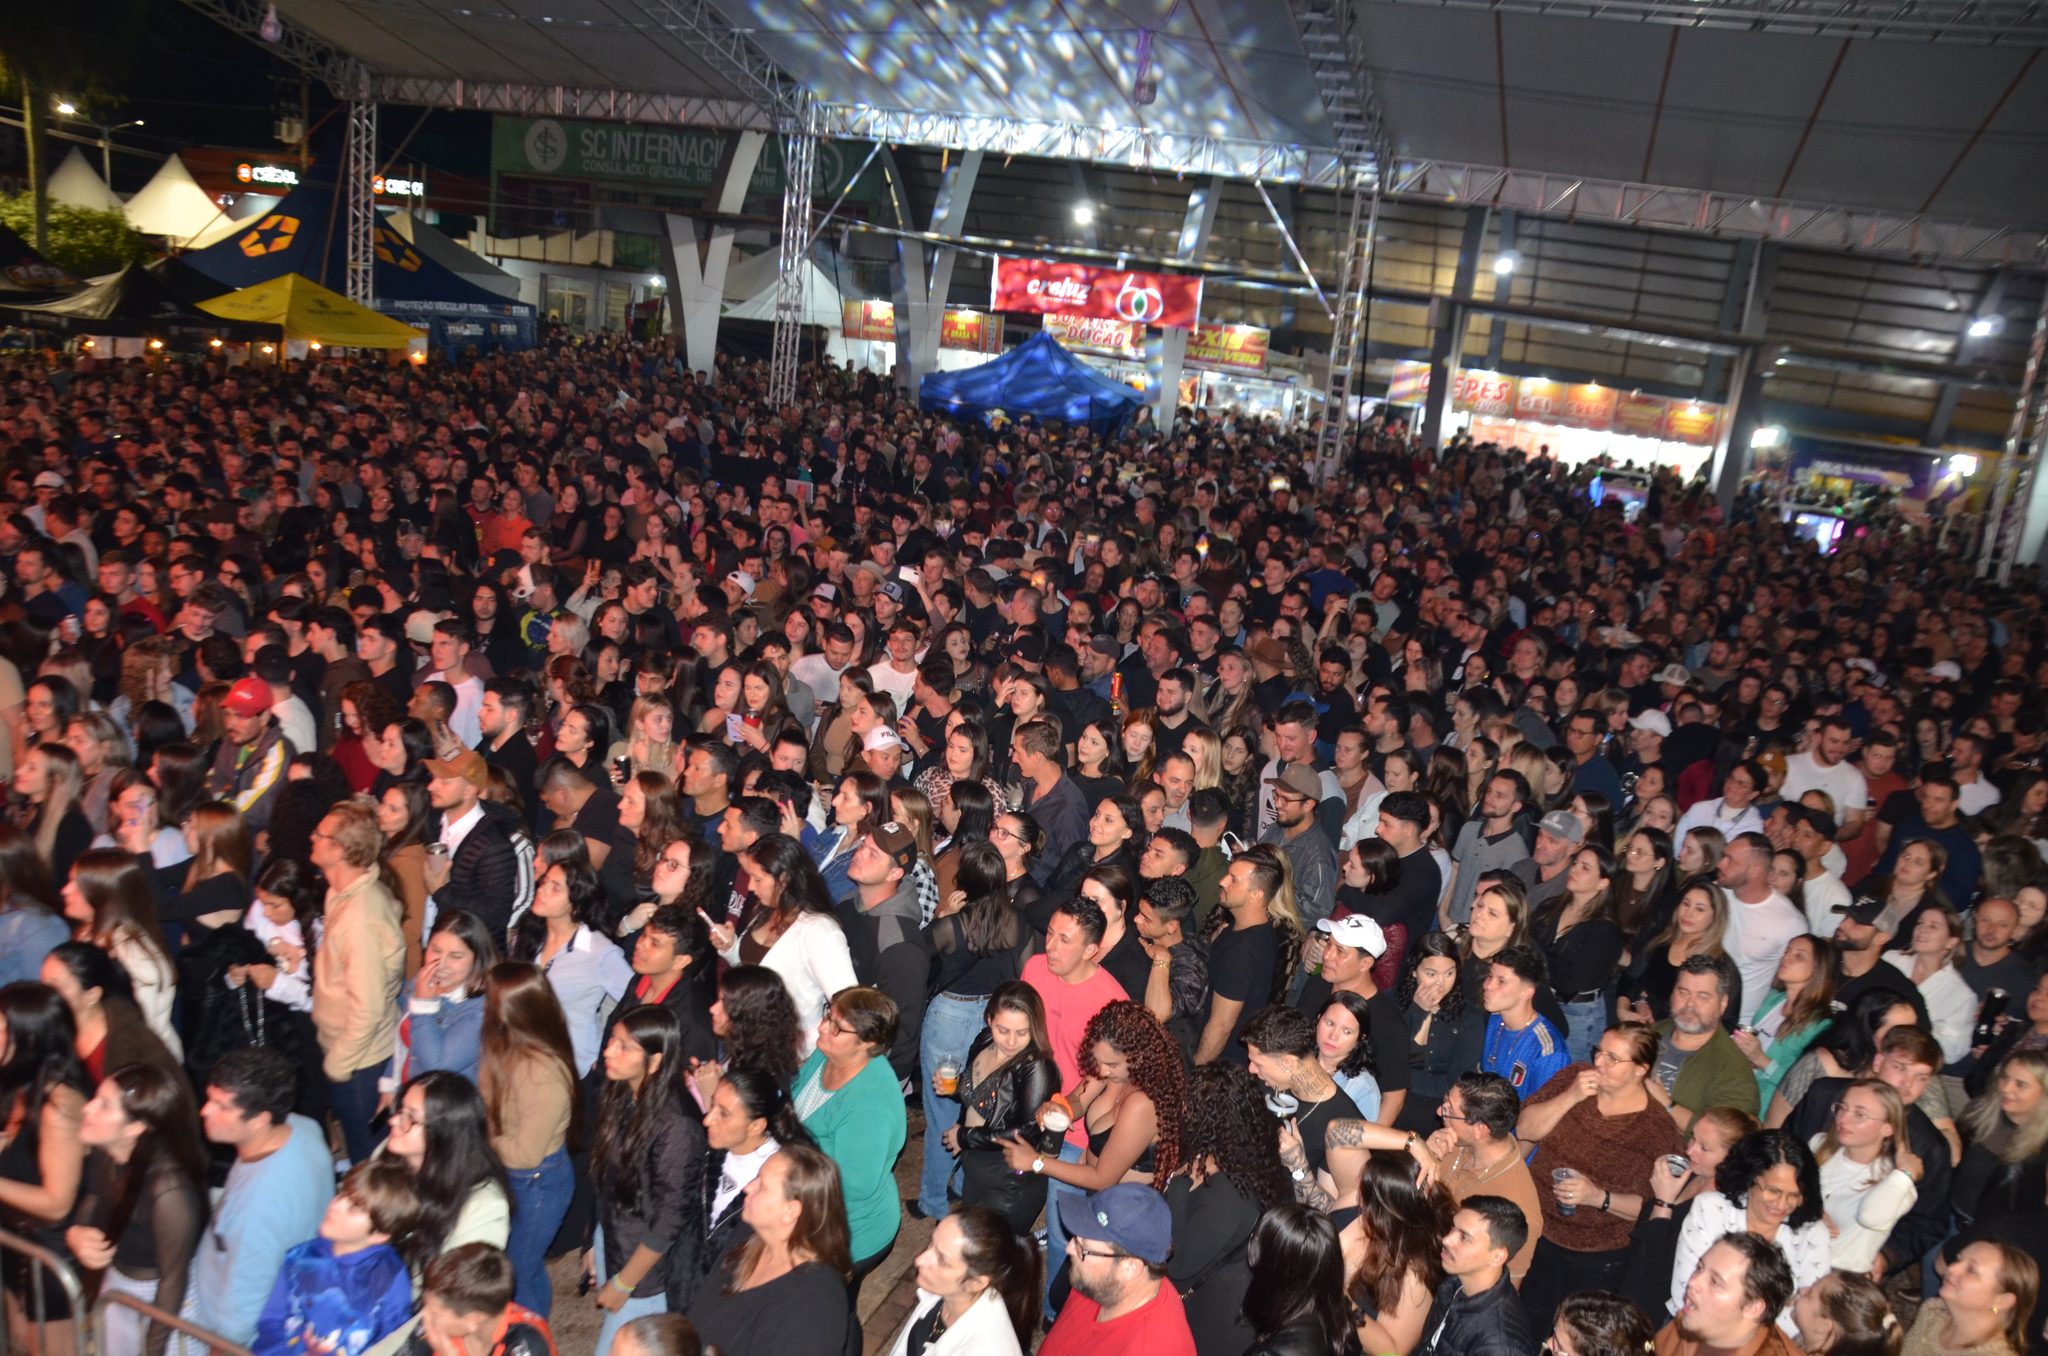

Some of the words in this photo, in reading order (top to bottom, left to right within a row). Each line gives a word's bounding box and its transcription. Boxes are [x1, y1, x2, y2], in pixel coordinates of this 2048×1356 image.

[580, 128, 607, 159] SC
[582, 159, 645, 178] CONSULADO
[696, 168, 713, 183] DE
[1026, 276, 1093, 300] creluz
[434, 301, 468, 312] VEICULAR
[468, 303, 490, 313] TOTAL
